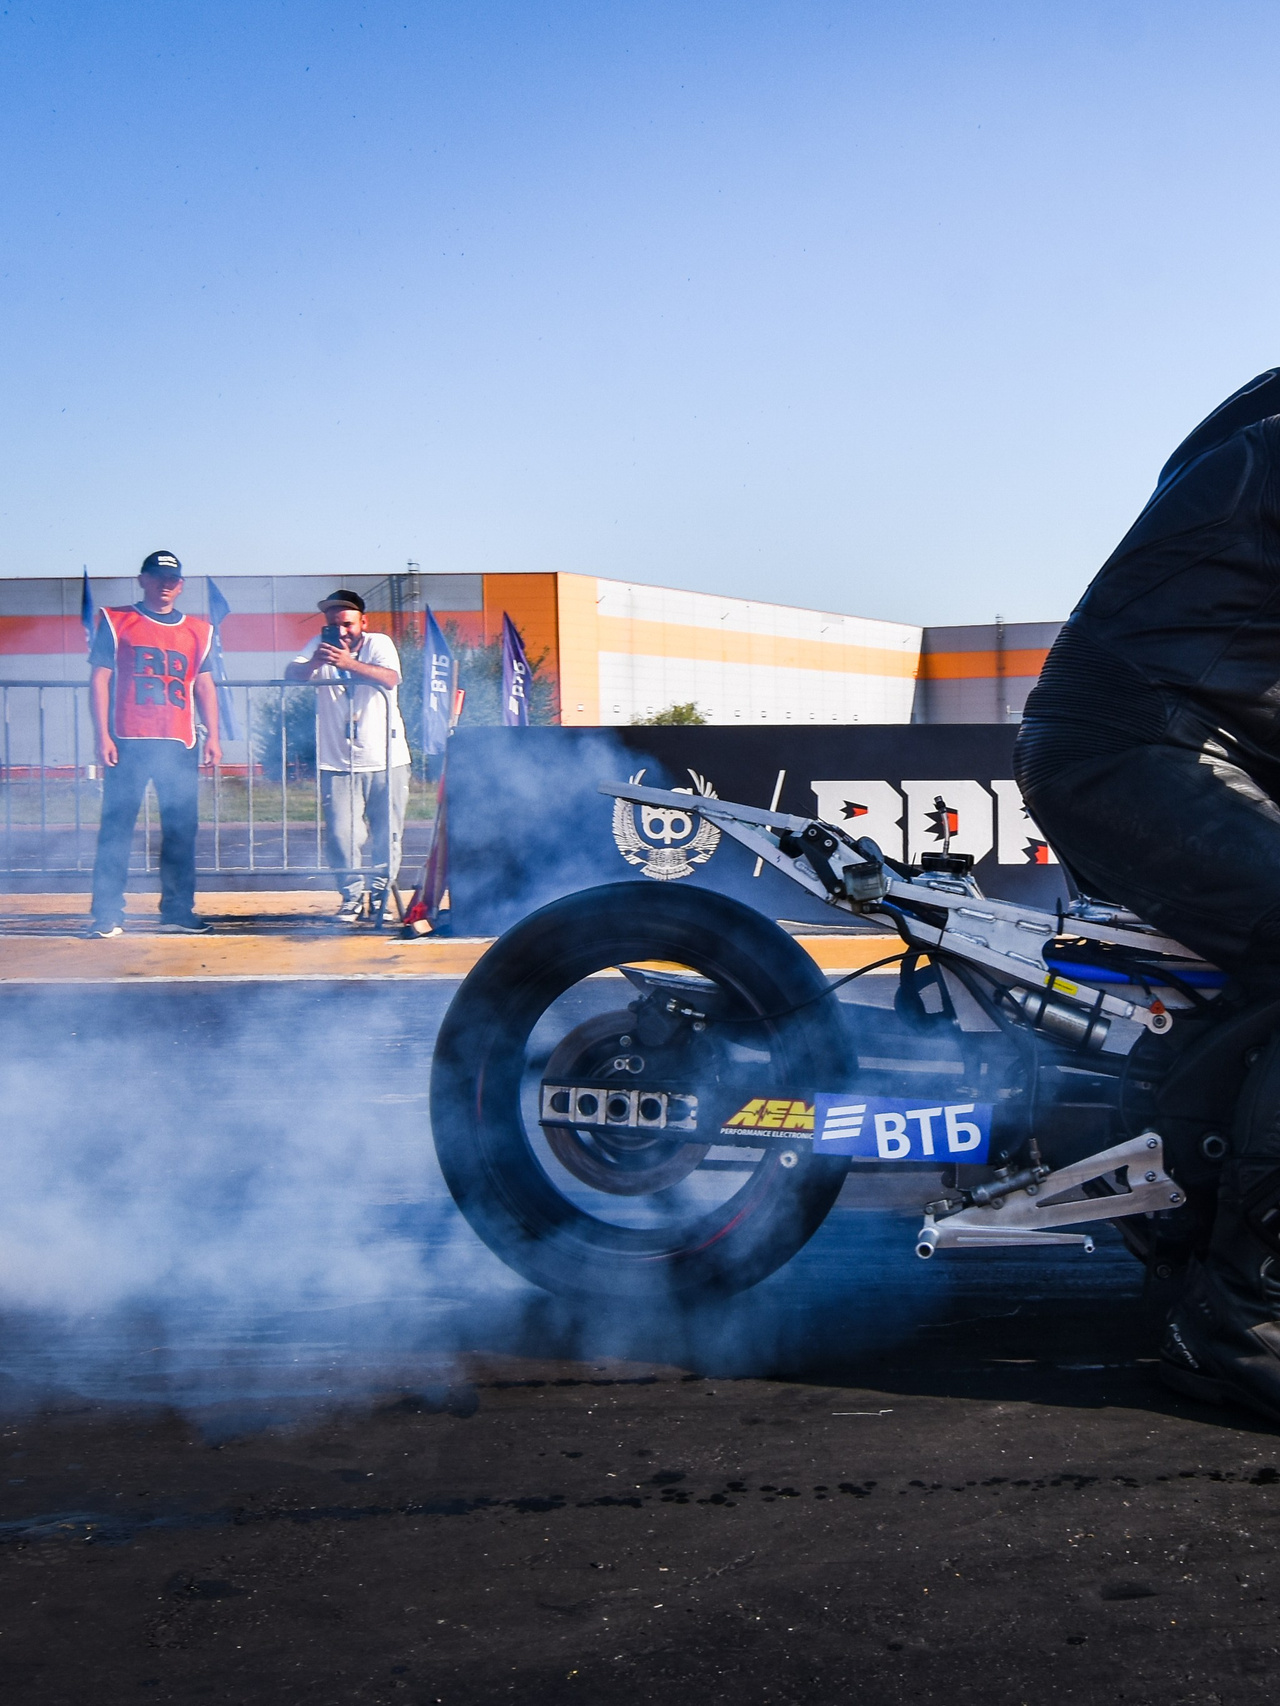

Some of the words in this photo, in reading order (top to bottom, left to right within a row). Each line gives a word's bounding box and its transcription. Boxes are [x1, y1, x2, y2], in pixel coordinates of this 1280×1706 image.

[430, 654, 450, 693] ВТБ
[726, 1098, 815, 1130] AEM
[874, 1103, 983, 1160] ВТБ
[720, 1127, 771, 1138] PERFORMANCE
